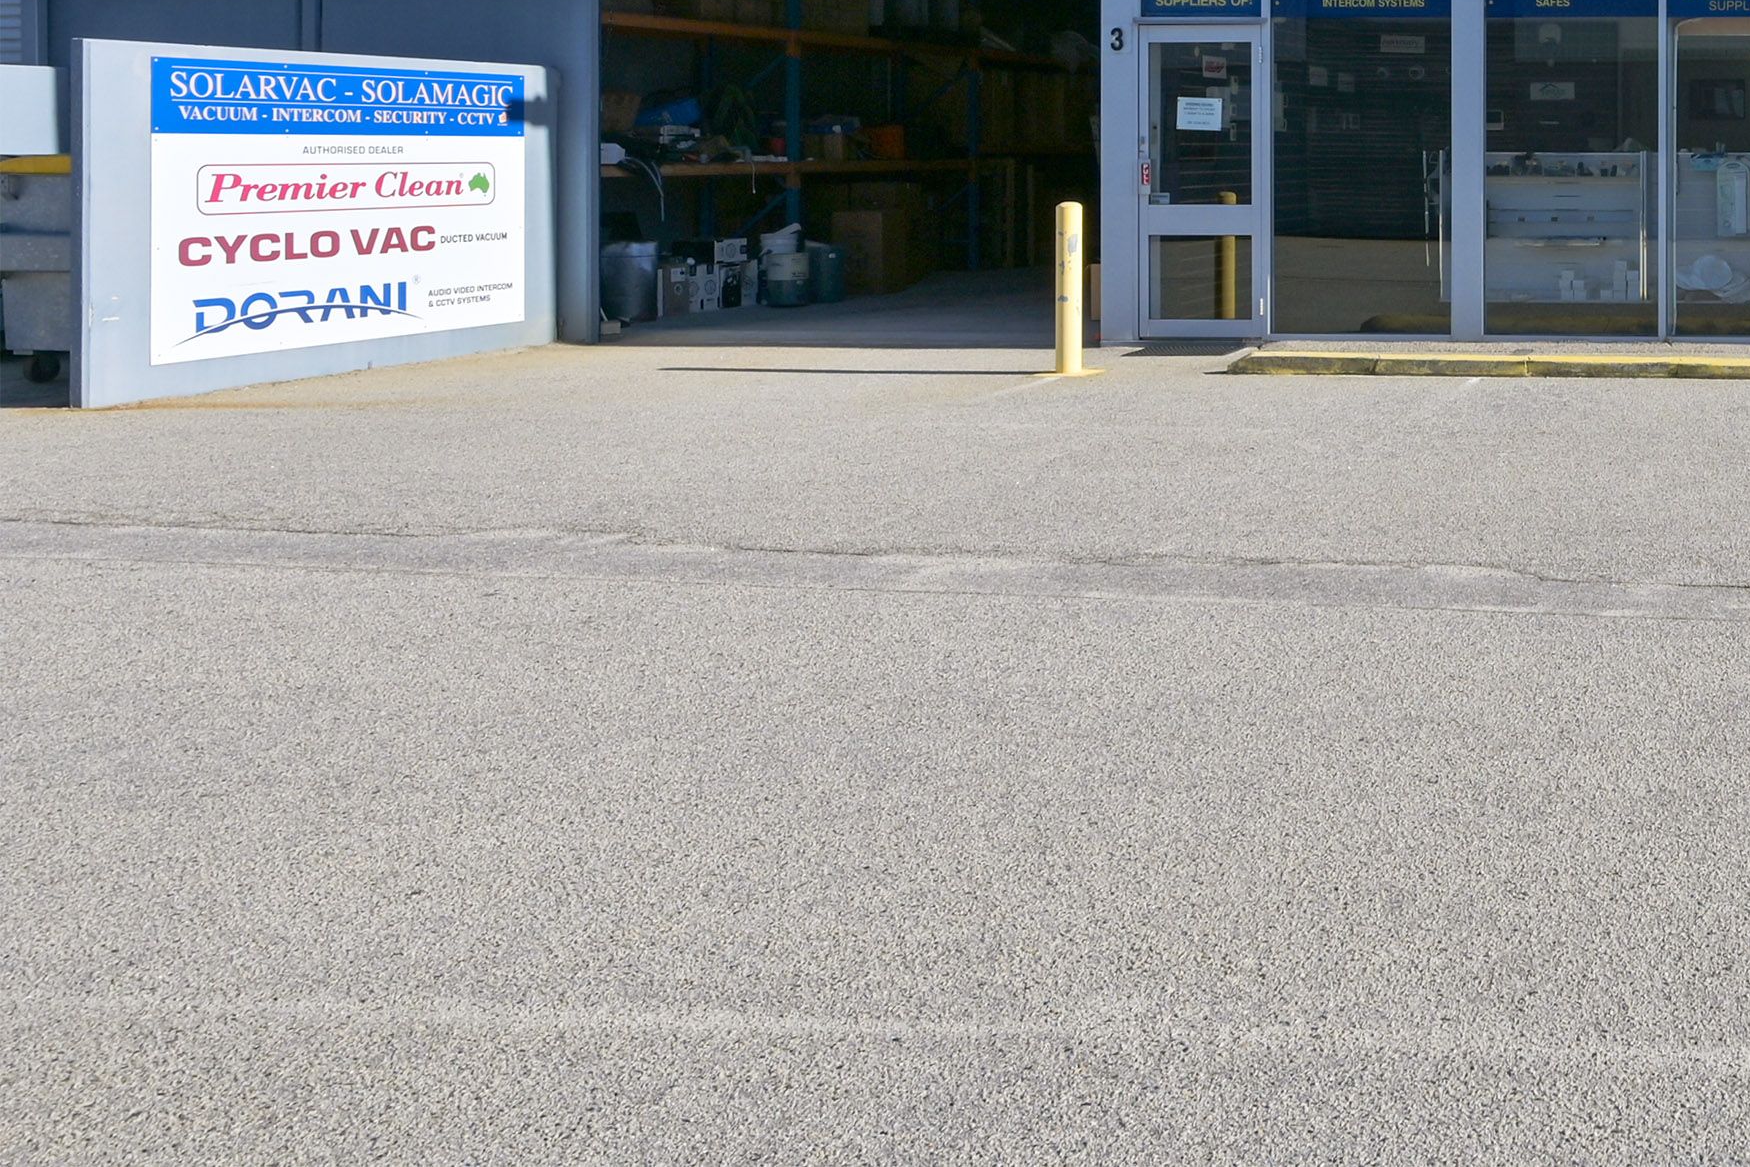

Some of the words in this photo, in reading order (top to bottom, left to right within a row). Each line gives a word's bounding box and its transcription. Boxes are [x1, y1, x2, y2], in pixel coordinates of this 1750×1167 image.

[1110, 28, 1124, 51] 3
[170, 71, 337, 102] SOLARVAC
[361, 79, 514, 107] SOLAMAGIC
[178, 105, 258, 121] VACUUM
[271, 108, 361, 123] INTERCOM
[373, 110, 447, 124] SECURITY
[457, 112, 495, 125] CCTV
[302, 146, 365, 155] AUTHORISED
[368, 146, 404, 154] DEALER
[204, 173, 367, 203] Premier
[375, 171, 463, 198] Clean
[178, 230, 340, 267] CYCLO
[350, 225, 436, 256] VAC
[440, 234, 473, 244] DUCTED
[475, 232, 508, 242] VACUUM
[428, 288, 452, 297] AUDIO
[454, 286, 475, 295] VIDEO
[477, 282, 514, 293] INTERCOM
[192, 281, 407, 333] DORANI
[436, 298, 455, 307] CCTV
[457, 295, 491, 305] SYSTEMS
